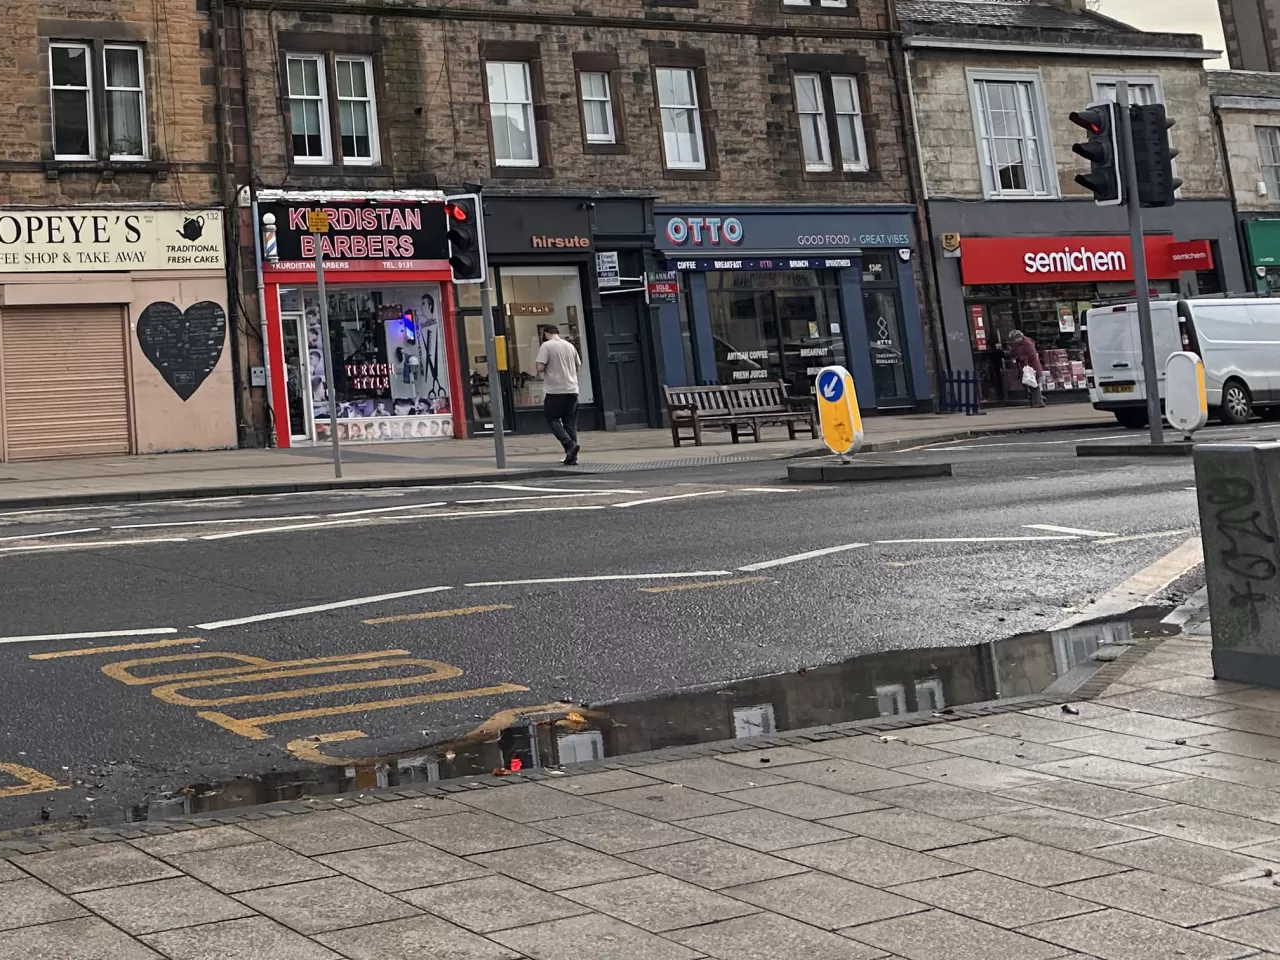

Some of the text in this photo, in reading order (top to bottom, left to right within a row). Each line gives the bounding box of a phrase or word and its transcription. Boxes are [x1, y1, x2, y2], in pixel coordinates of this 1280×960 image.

[206, 212, 219, 220] 132
[666, 217, 745, 245] OTTO
[532, 235, 590, 248] hirsute
[797, 234, 909, 245] GOOD FOOD GREAT VIBES
[166, 244, 219, 253] TRADITIONAL
[300, 235, 415, 257] BARBERS
[24, 252, 59, 264] SHOP
[63, 252, 72, 263] &
[76, 251, 111, 263] TAKE
[114, 251, 147, 263] AWAY
[194, 255, 219, 263] CAKES
[1024, 247, 1127, 273] semichem
[1172, 252, 1207, 261] semichem
[276, 262, 316, 270] KURDISTAN
[321, 261, 350, 269] ARBERS
[398, 261, 413, 269] 0131
[677, 261, 697, 270] COFFEE
[714, 260, 743, 269] BREAKFAST
[789, 260, 809, 268] BRUNCH
[825, 259, 851, 268] SMOOTHIES
[749, 350, 769, 359] COFFEE
[800, 348, 829, 357] BREAKFAST
[732, 370, 750, 380] FRESH
